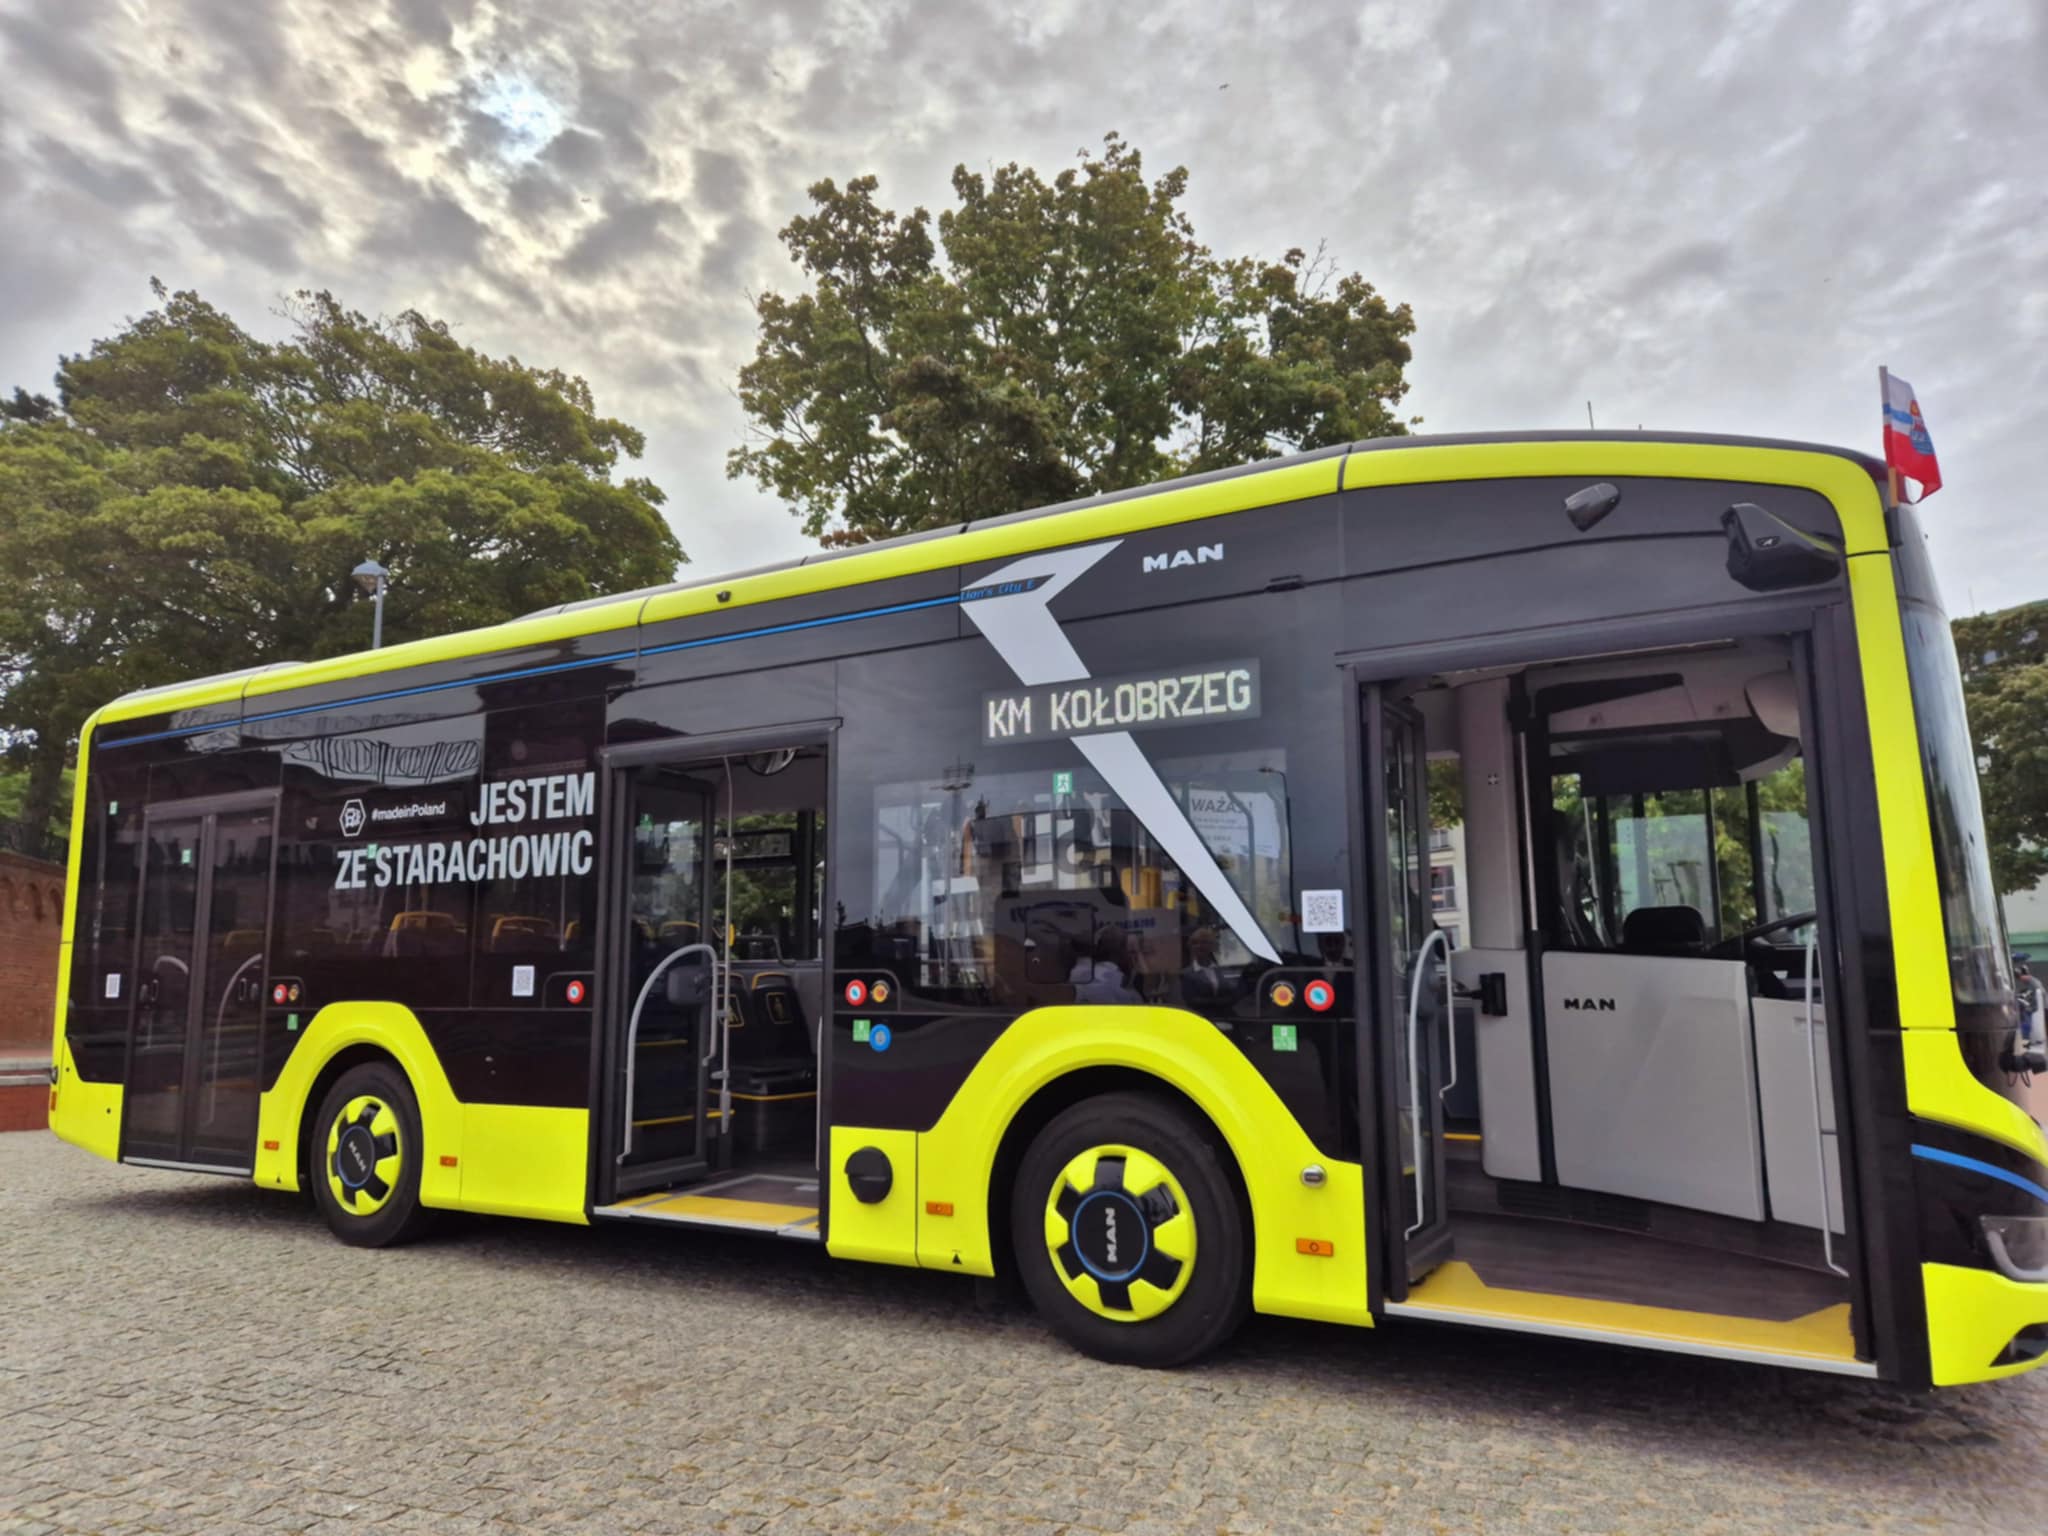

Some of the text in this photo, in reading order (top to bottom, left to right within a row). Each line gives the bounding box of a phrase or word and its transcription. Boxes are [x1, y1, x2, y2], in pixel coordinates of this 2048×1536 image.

[1143, 543, 1224, 573] MAN
[988, 669, 1251, 738] KM KOŁOBRZEG
[371, 801, 446, 821] #madeinPoland
[470, 772, 596, 826] JESTEM
[334, 829, 594, 890] ZE STARACHOWIC
[1564, 998, 1616, 1011] MAN
[349, 1140, 367, 1172] MAN
[1105, 1207, 1118, 1263] MAN
